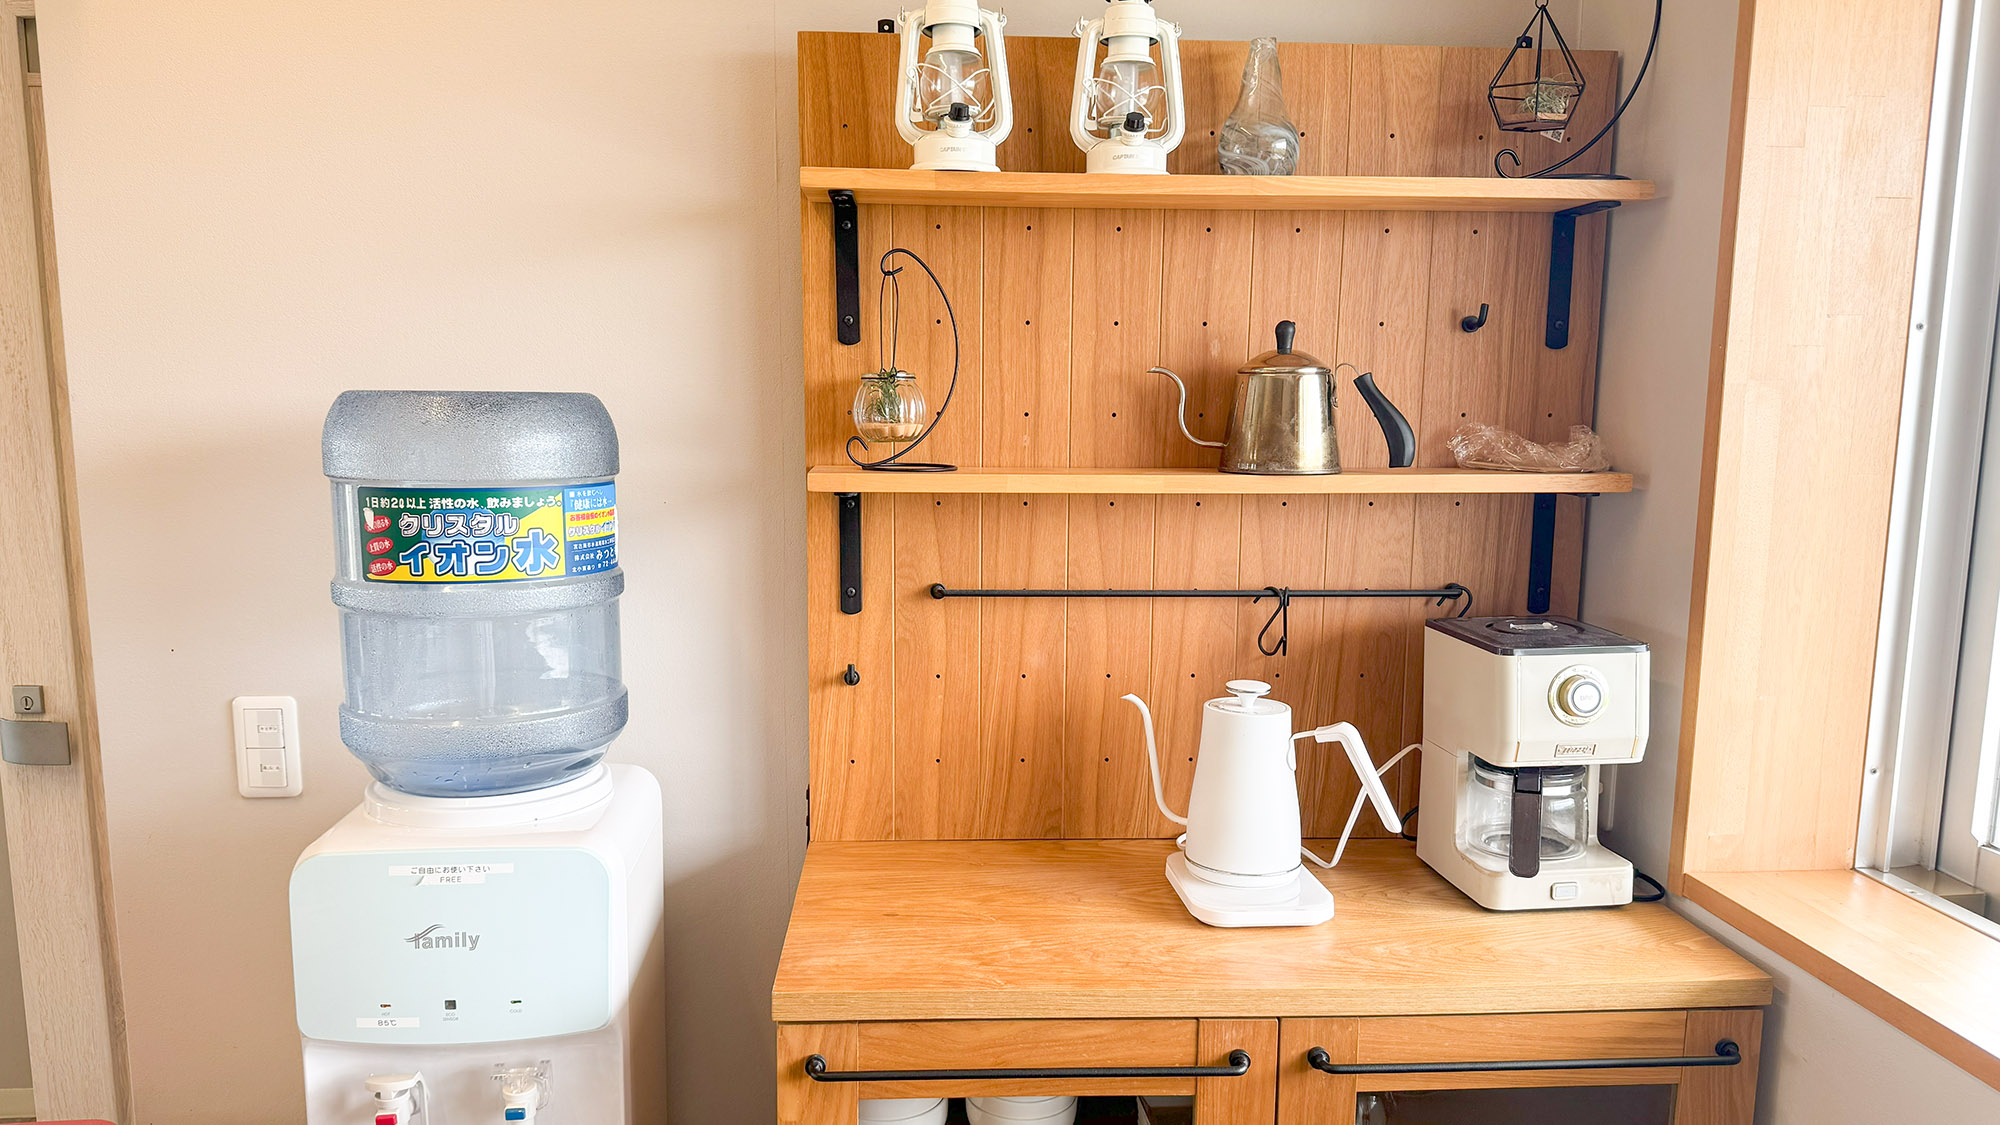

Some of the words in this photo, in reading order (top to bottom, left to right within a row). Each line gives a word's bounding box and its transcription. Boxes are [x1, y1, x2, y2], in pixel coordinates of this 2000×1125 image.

[398, 512, 521, 538] クリスタル
[398, 529, 560, 576] イオン水
[410, 865, 491, 875] ご自由にお使い下さい
[439, 875, 462, 883] FREE
